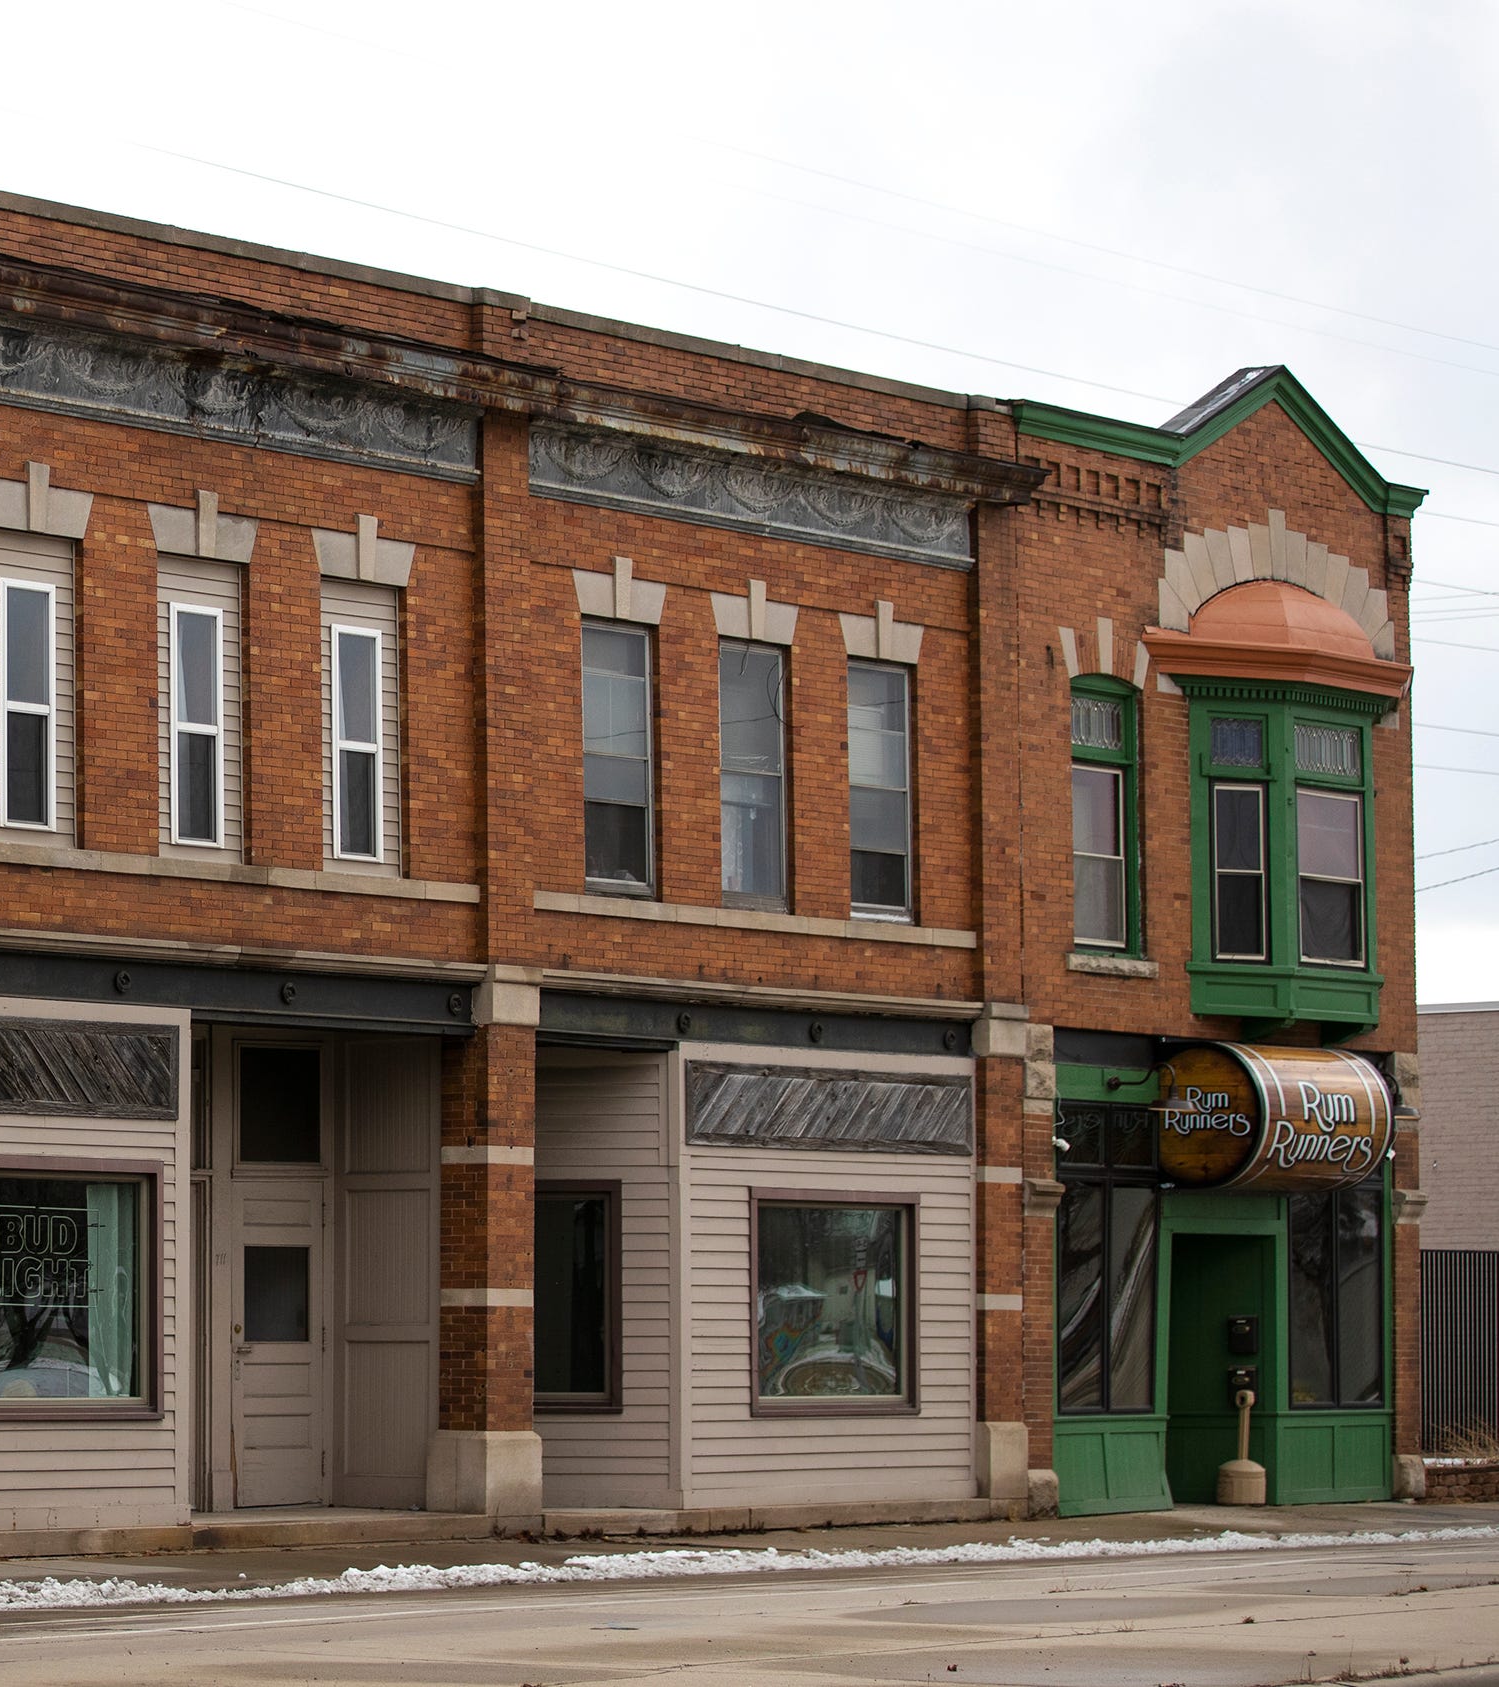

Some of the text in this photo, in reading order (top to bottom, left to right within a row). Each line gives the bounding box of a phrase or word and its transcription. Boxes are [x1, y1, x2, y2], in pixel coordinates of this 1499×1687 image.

[1186, 1086, 1229, 1113] Rum
[1297, 1080, 1356, 1132] Rum
[1164, 1109, 1251, 1136] Runners
[1266, 1120, 1373, 1172] Runners
